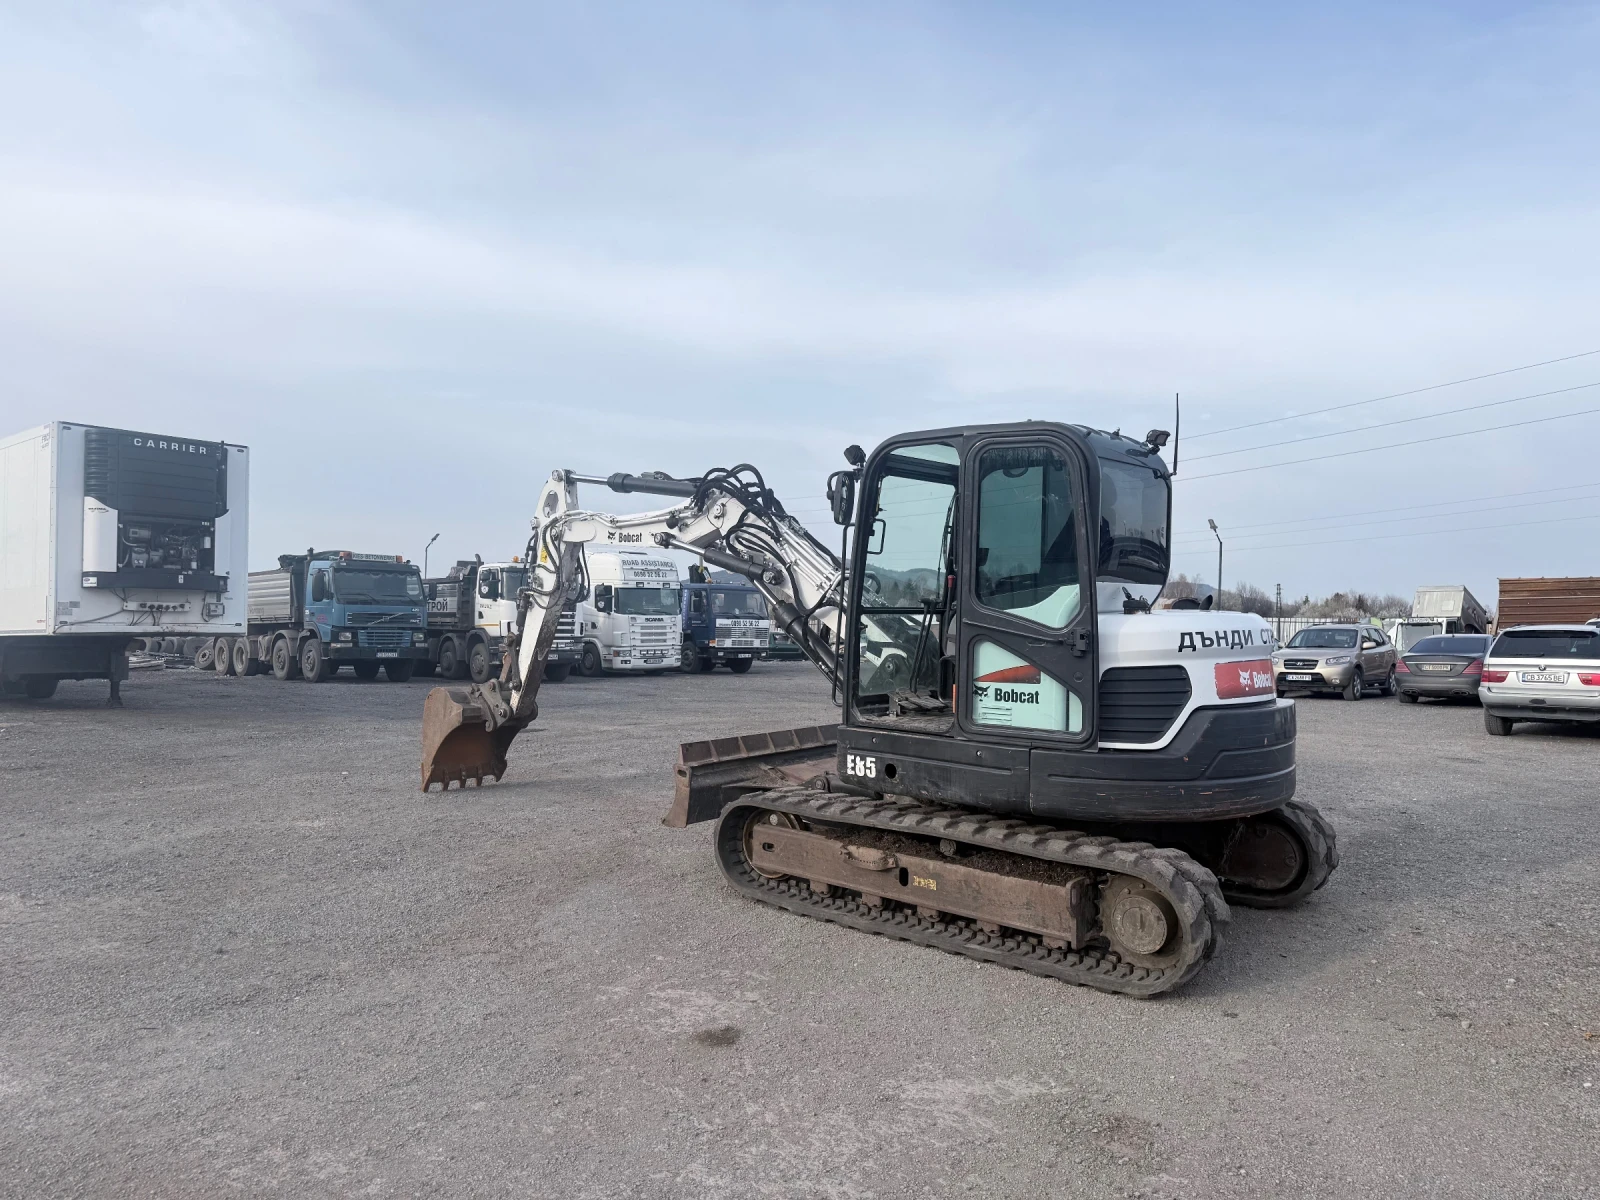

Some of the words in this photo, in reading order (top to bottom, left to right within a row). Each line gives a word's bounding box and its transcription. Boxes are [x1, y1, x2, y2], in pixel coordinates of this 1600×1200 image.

[134, 438, 207, 454] CARRIER
[618, 532, 642, 543] Bobcat
[1178, 630, 1253, 652] ДЪНДИ
[994, 688, 1040, 704] Bobcat
[847, 754, 876, 778] E85
